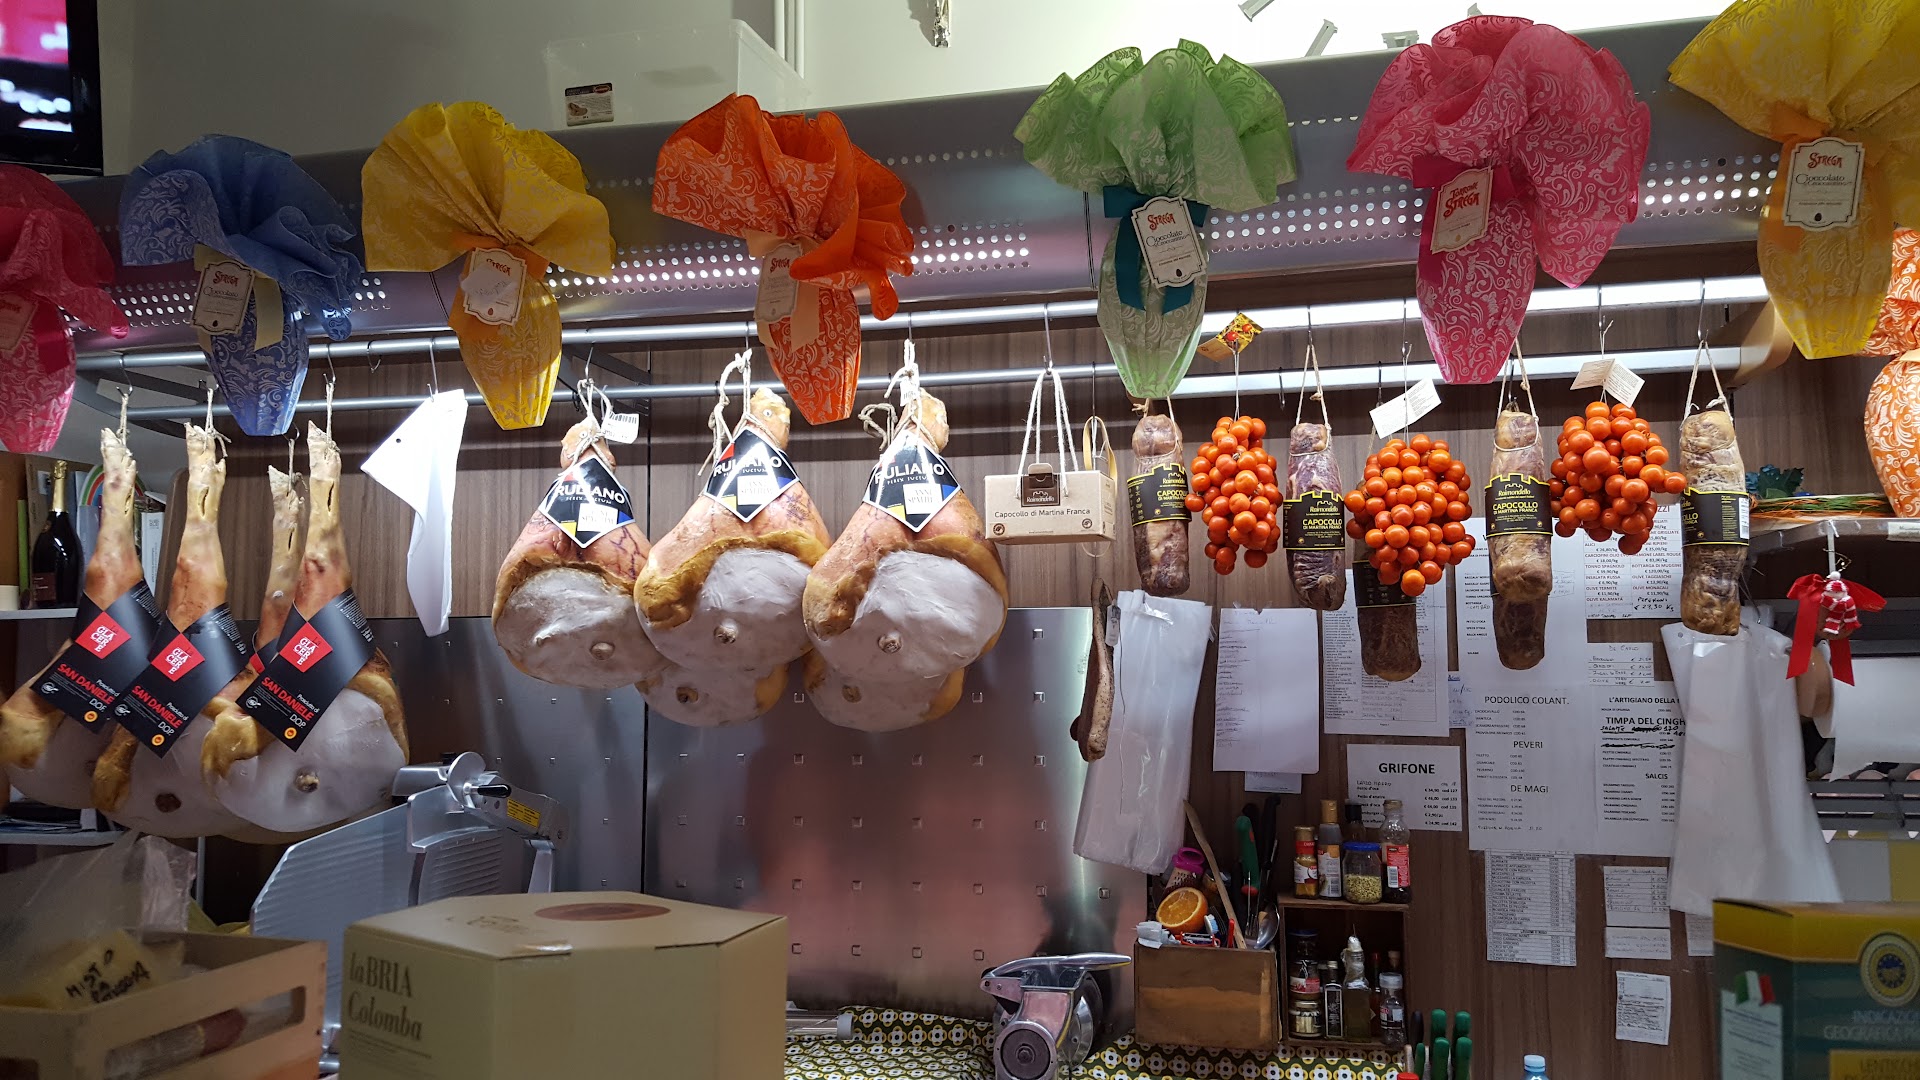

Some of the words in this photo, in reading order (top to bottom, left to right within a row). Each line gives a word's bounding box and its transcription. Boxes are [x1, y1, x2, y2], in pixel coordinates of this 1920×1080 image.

[1493, 501, 1538, 510] CAPOCOLLO
[994, 509, 1029, 519] Capocollo
[1030, 509, 1037, 517] di
[1039, 508, 1065, 517] Martina
[1066, 507, 1091, 516] Franca
[57, 663, 79, 681] SAN
[76, 675, 115, 705] DANIELE
[261, 677, 281, 695] SAN
[278, 690, 315, 721] DANIELE
[1485, 696, 1529, 704] PODOLICO
[132, 685, 152, 703] SAN
[148, 698, 183, 728] DANIELE
[1638, 717, 1654, 725] DEL
[1656, 718, 1686, 726] CINGH
[1513, 741, 1543, 749] PEVERI
[1379, 763, 1435, 774] GRIFONE
[1510, 785, 1522, 793] DE
[1524, 785, 1549, 793] MAGI
[348, 990, 422, 1041] Colomba
